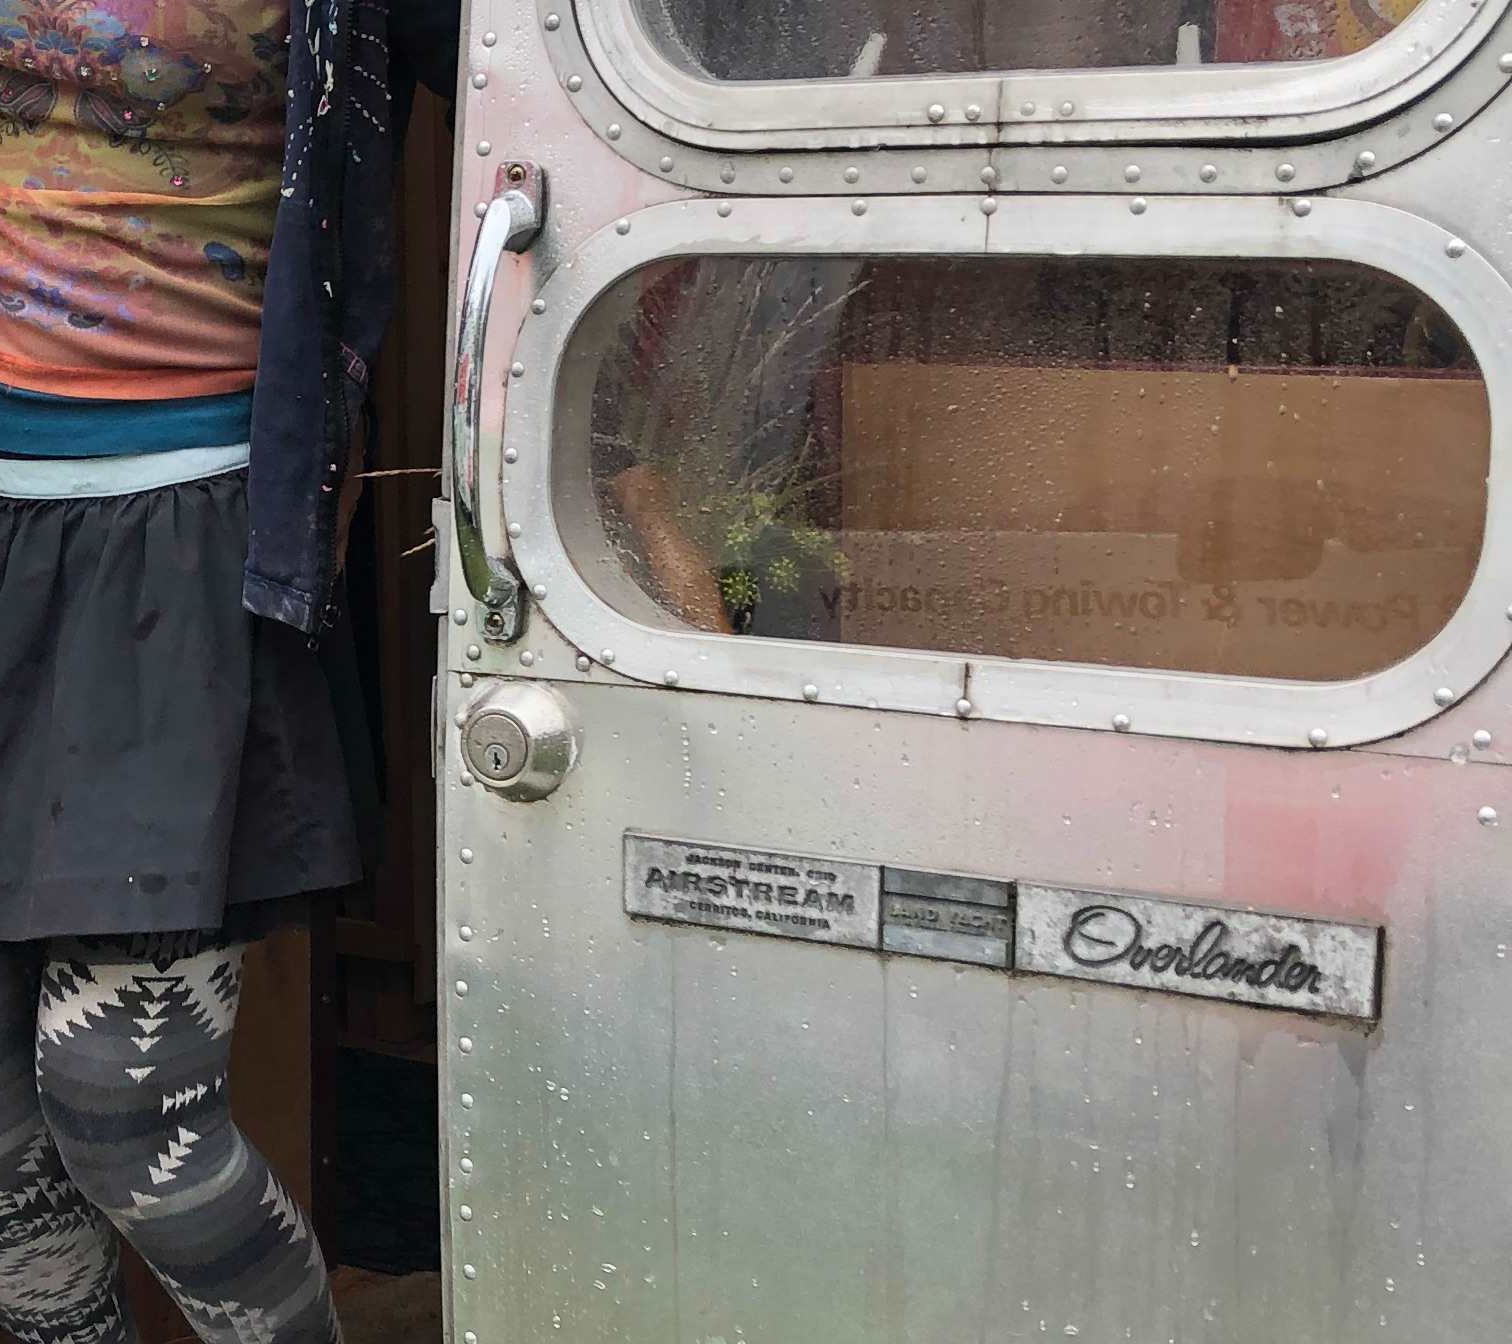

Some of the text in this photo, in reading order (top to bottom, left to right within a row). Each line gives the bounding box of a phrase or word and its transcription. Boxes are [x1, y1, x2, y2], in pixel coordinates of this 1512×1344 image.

[645, 866, 856, 915] AIRSTREAM
[755, 909, 831, 930] CALIFORNIA
[1064, 905, 1323, 994] Overlander
